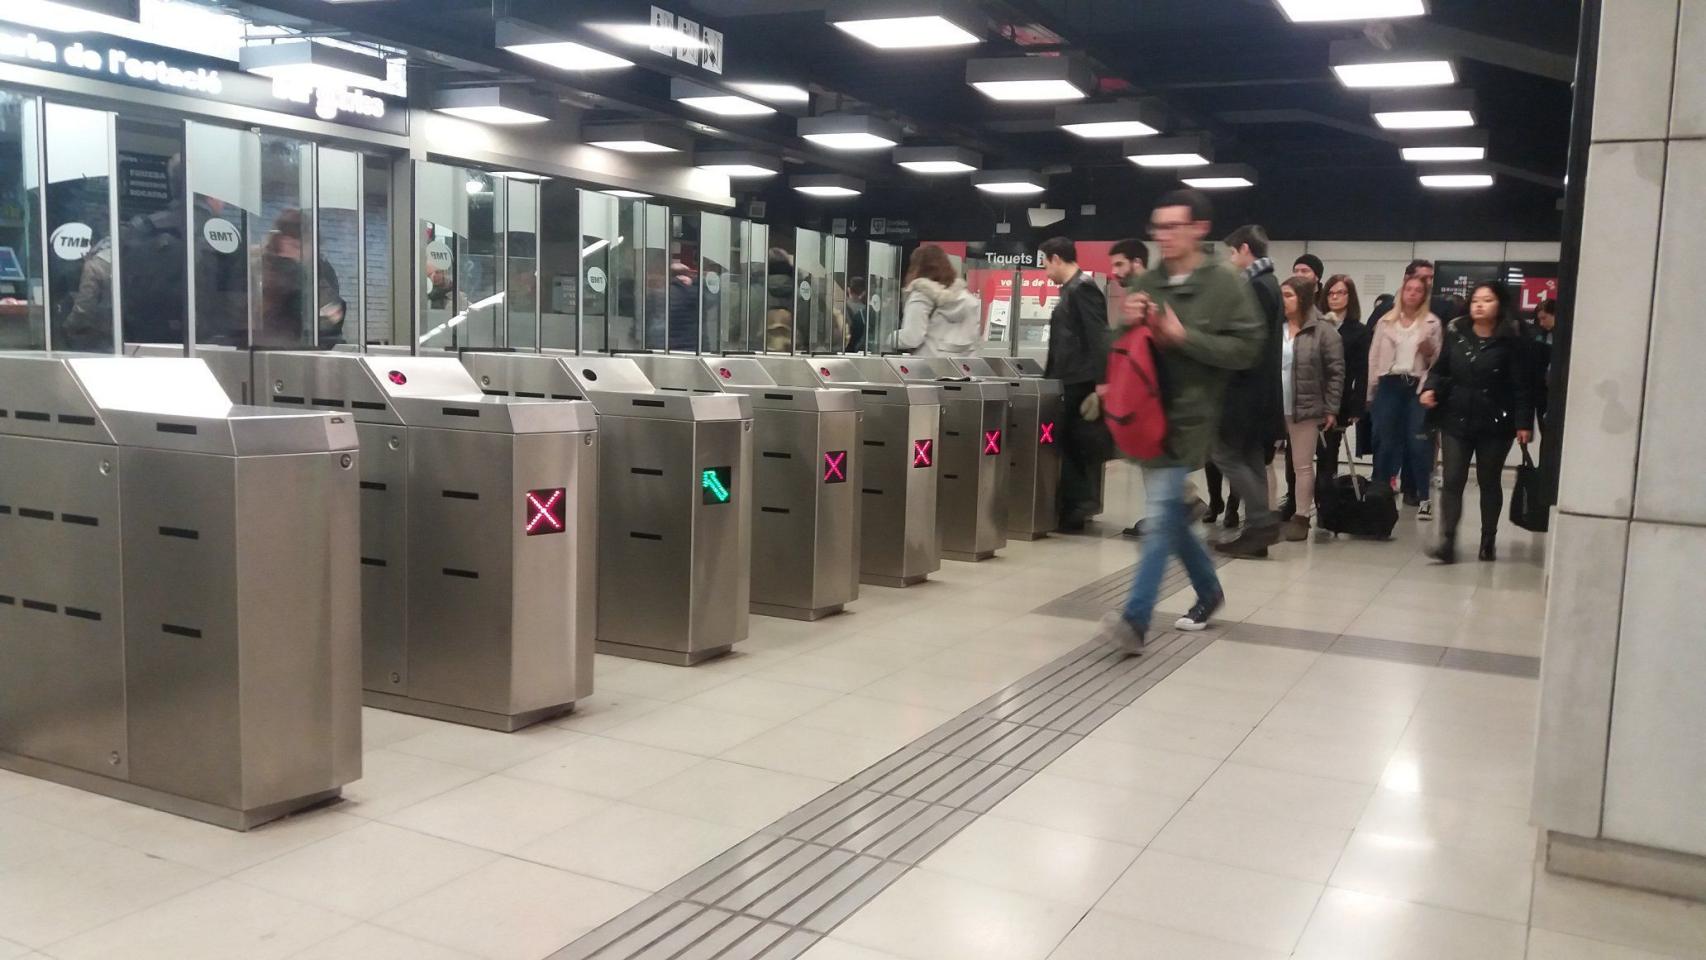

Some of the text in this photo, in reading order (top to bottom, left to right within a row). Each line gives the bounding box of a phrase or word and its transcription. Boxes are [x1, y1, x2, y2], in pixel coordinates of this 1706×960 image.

[64, 42, 102, 71] de
[985, 252, 1033, 266] Tiquets
[1522, 288, 1547, 309] L1
